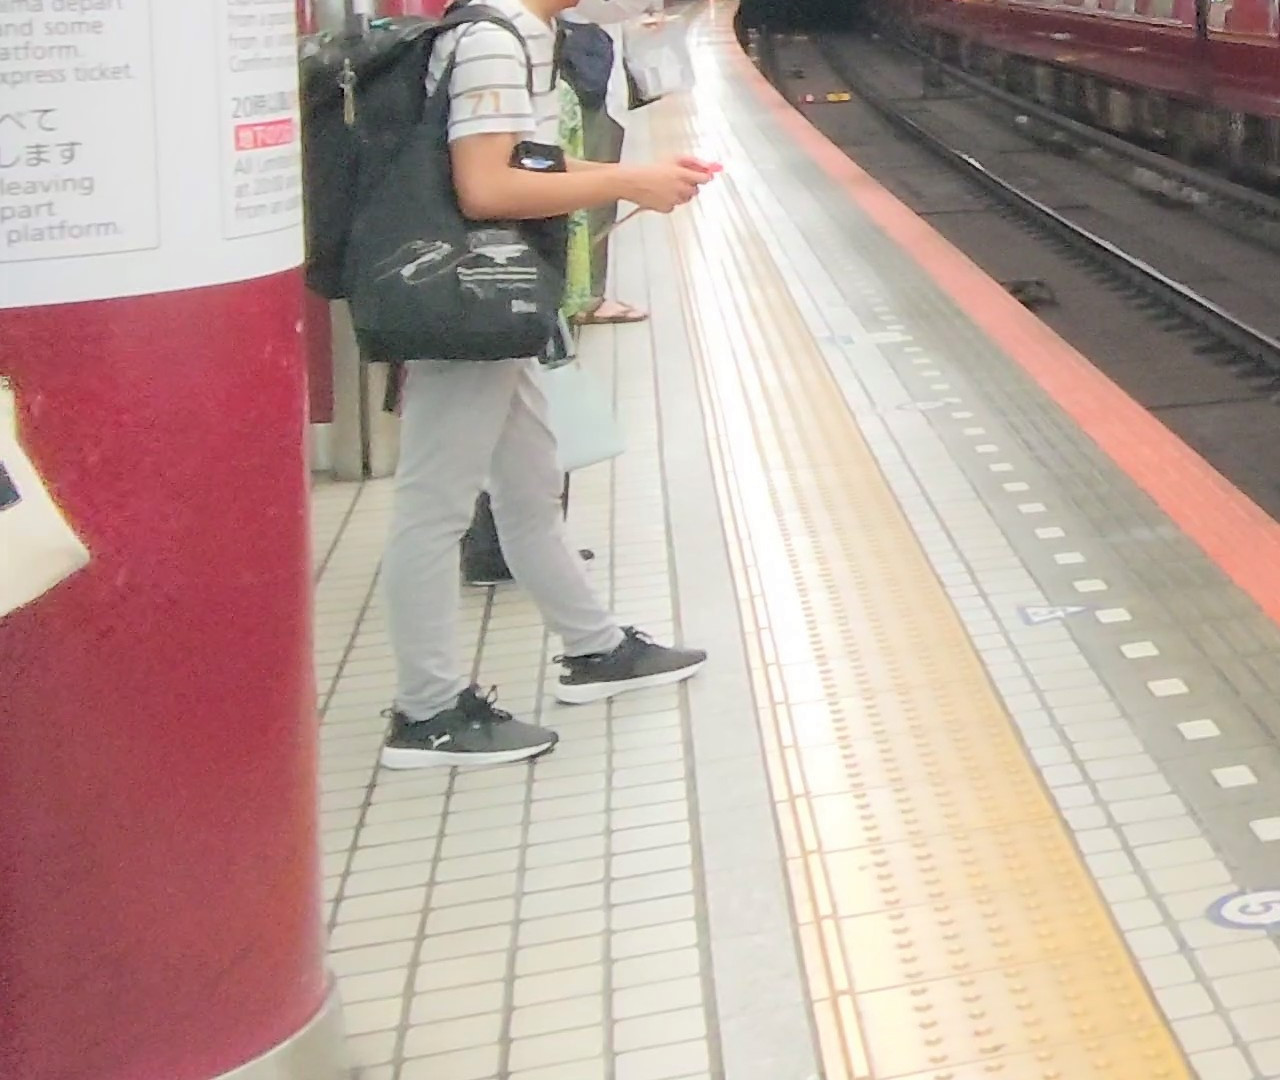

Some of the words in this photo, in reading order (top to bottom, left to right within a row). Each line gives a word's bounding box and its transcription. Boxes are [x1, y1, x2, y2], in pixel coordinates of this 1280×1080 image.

[44, 21, 104, 36] some
[0, 176, 95, 196] leaving
[0, 201, 56, 223] part
